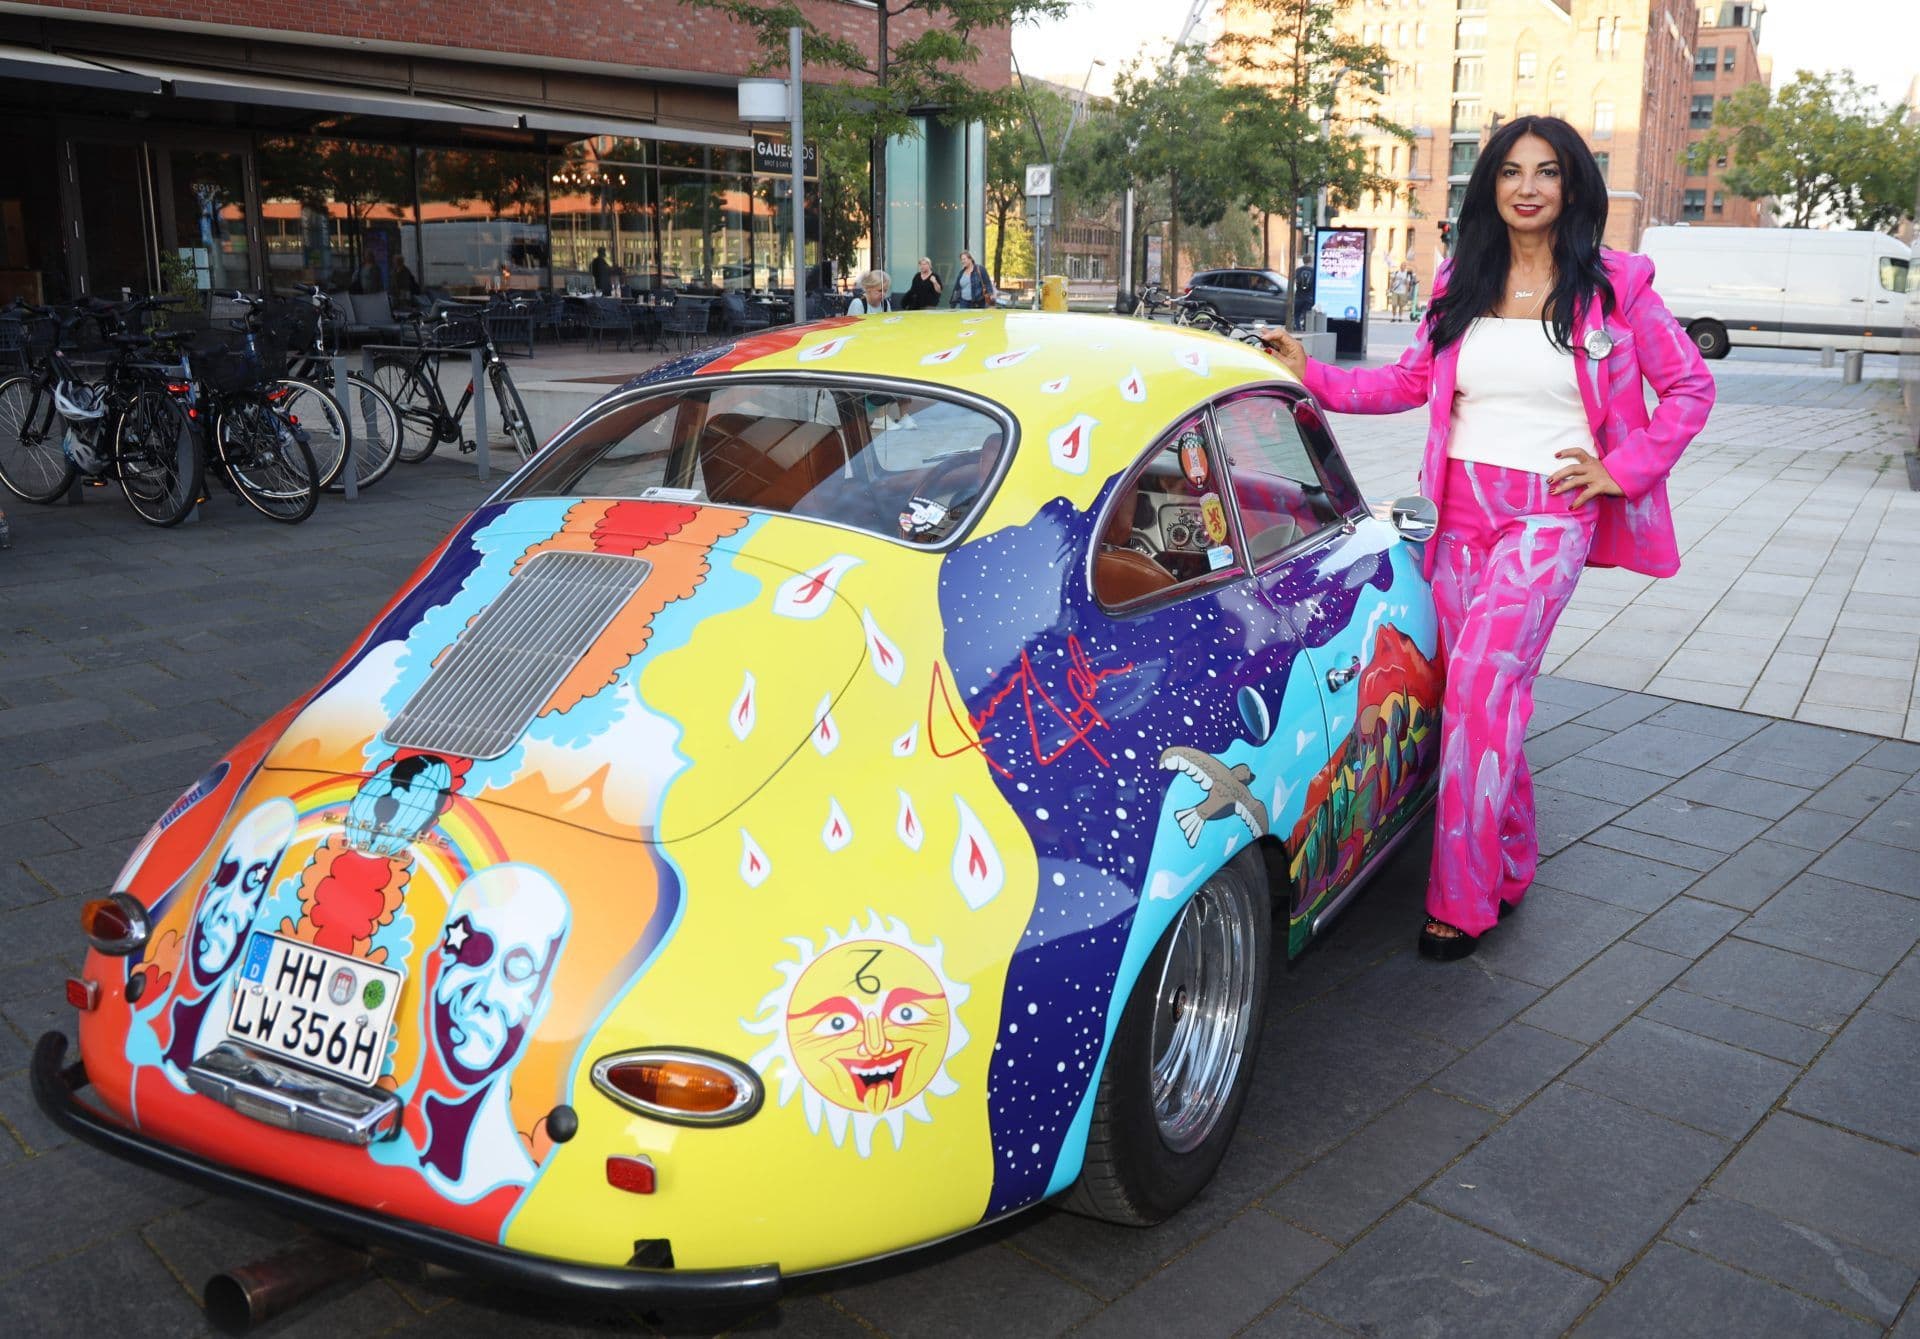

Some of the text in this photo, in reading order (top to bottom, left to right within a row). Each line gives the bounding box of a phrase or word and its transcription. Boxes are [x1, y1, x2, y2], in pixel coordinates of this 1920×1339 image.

[757, 141, 793, 158] GAUES
[321, 811, 449, 849] PORSCHE
[250, 964, 260, 978] D
[276, 949, 327, 1002] HH
[233, 990, 378, 1075] LW 356H
